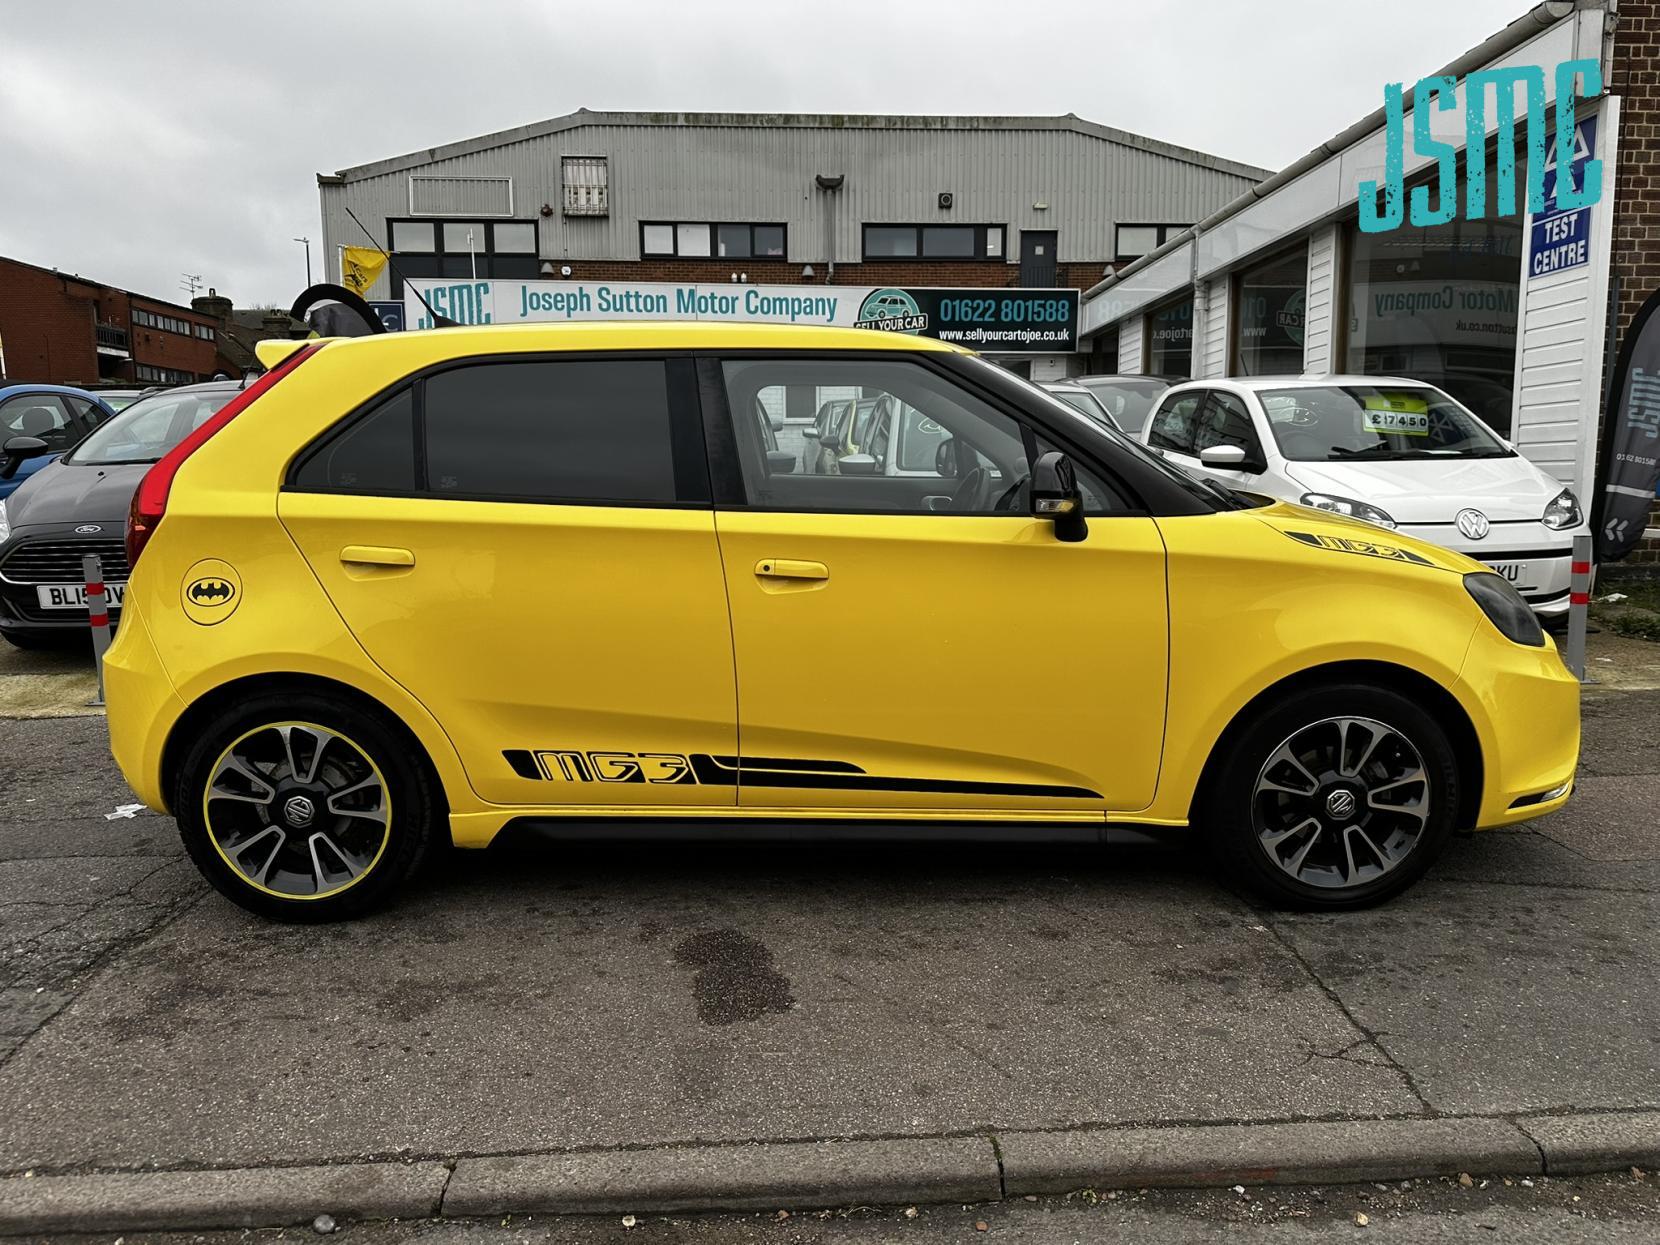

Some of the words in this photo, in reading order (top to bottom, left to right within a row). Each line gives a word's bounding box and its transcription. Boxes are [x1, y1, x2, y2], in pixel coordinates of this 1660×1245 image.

[1544, 213, 1579, 244] TEST
[1533, 239, 1586, 275] CENTRE
[418, 282, 491, 330] JSMC
[519, 285, 591, 318] Joseph
[597, 286, 668, 313] Sutton
[676, 288, 739, 315] Motor
[745, 289, 838, 322] Company
[939, 299, 996, 322] 01622
[1000, 299, 1069, 322] 801588
[878, 319, 904, 331] YOUR
[904, 316, 925, 329] CAR
[938, 328, 1070, 343] www.sellyourcartojoe.co.uk
[1488, 564, 1519, 581] KU
[532, 749, 698, 785] MG3
